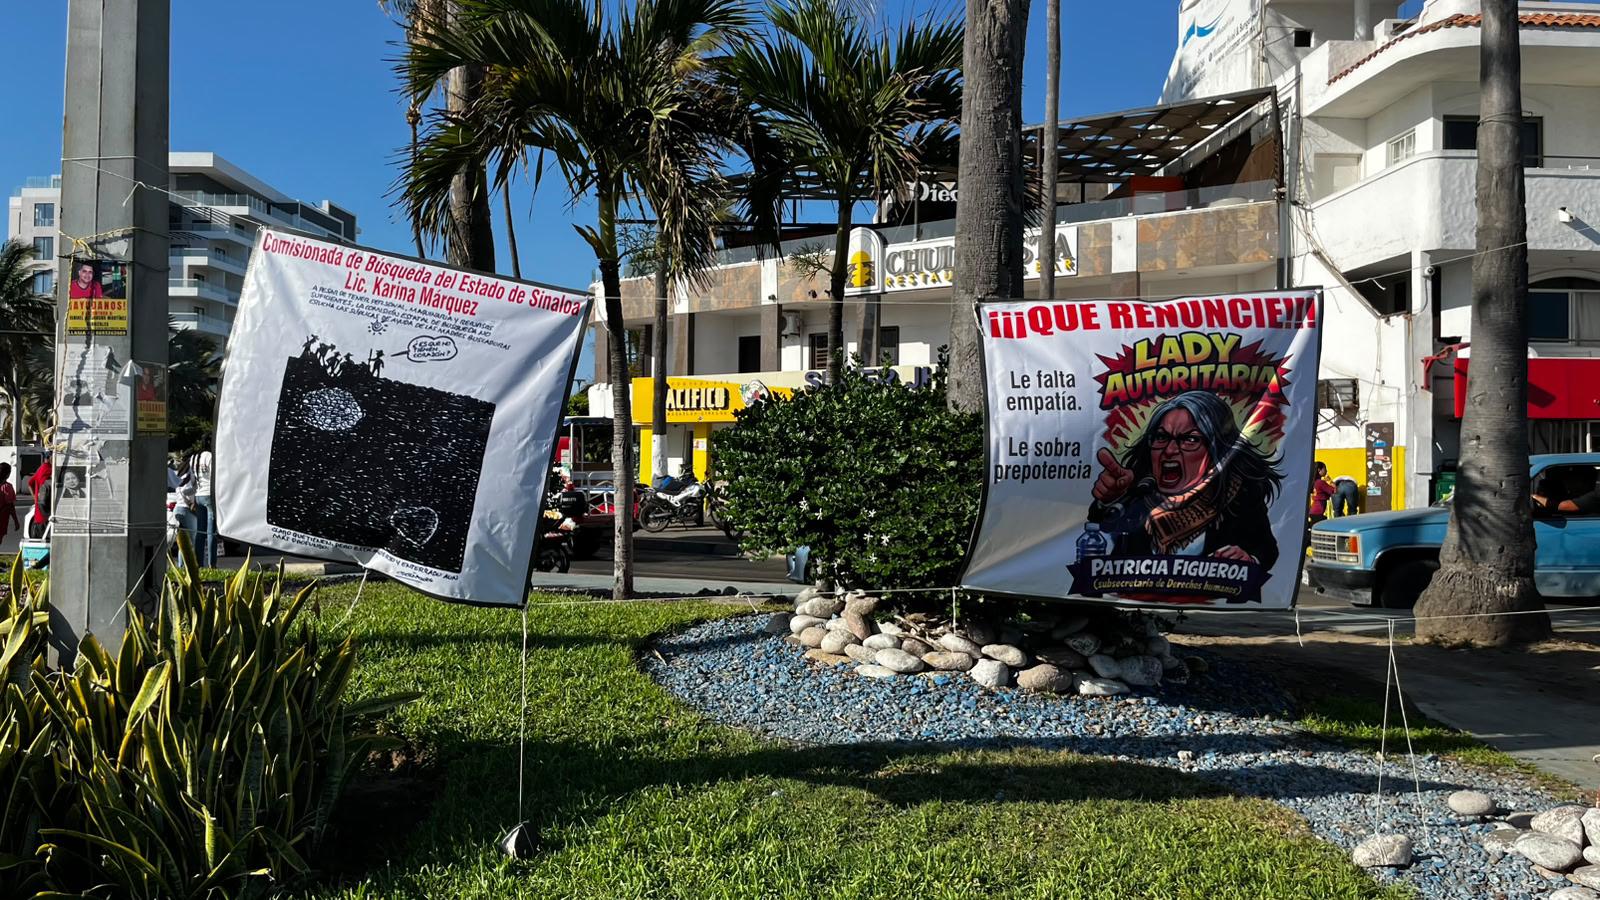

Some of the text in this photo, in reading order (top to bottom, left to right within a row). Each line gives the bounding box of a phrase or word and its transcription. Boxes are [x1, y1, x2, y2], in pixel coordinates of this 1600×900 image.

[262, 232, 581, 316] Comisionada de Búsqueda del Estado de Sinaloa
[345, 271, 479, 316] Lic. Karina Márquez
[1135, 333, 1240, 368] LADY
[1010, 369, 1076, 389] Le falta
[1102, 363, 1280, 404] AUTORITARIA
[666, 387, 727, 410] ACIFICO
[1006, 391, 1082, 415] empatía.
[1008, 436, 1081, 457] Le sobra
[993, 460, 1092, 484] prepotencia
[1091, 559, 1249, 581] PATRICIA FIGUEROA
[1155, 579, 1166, 588] de
[1166, 580, 1202, 590] Derechos
